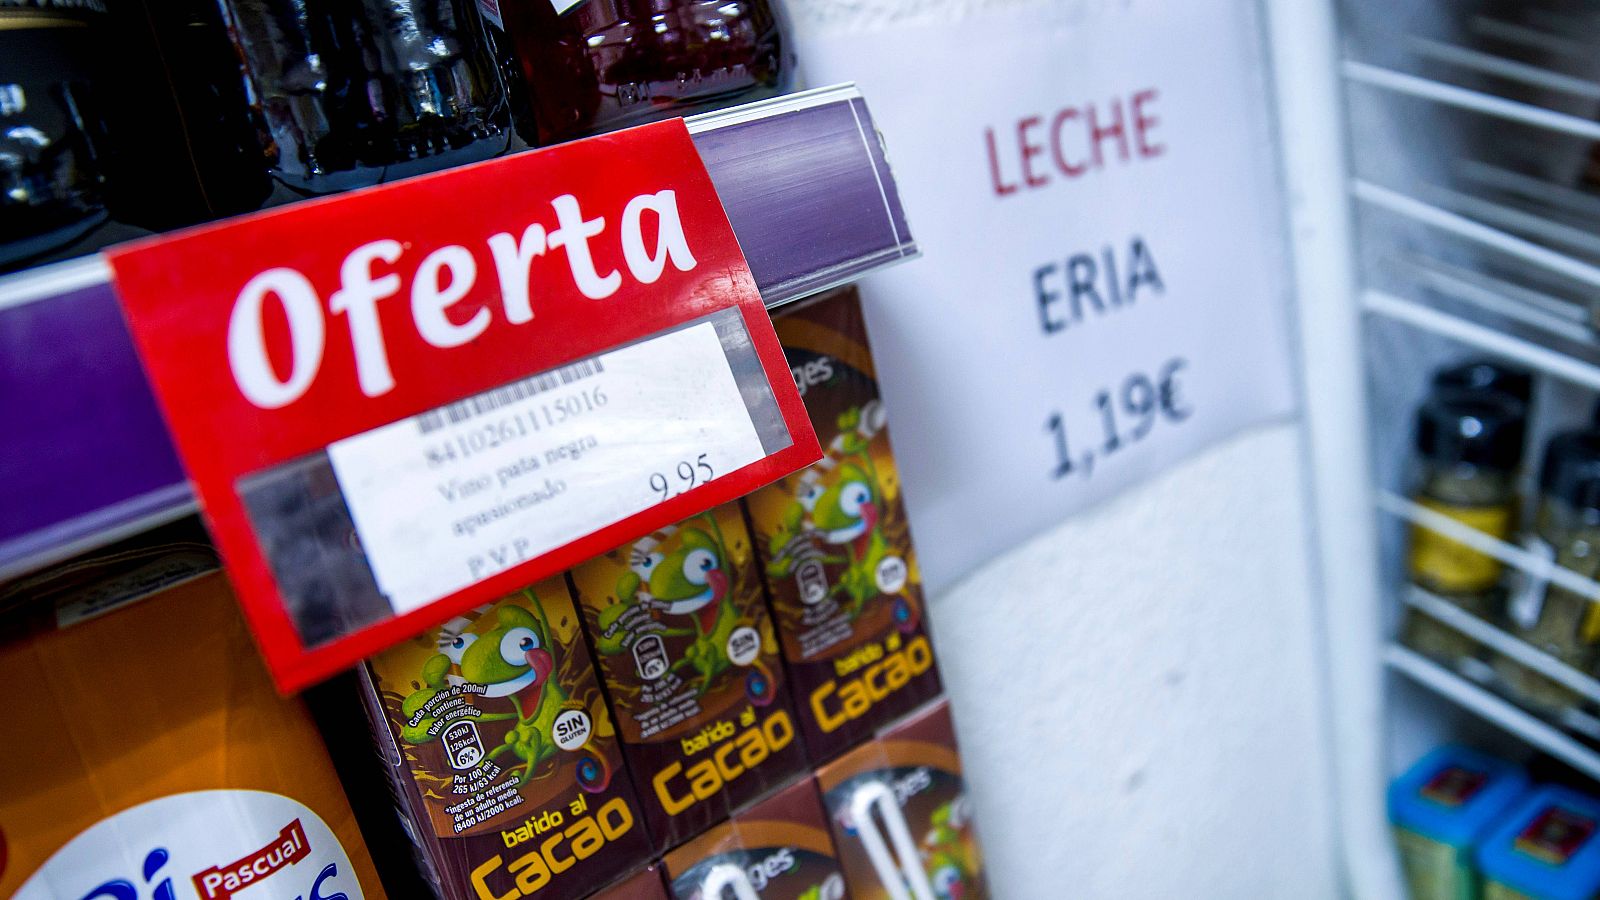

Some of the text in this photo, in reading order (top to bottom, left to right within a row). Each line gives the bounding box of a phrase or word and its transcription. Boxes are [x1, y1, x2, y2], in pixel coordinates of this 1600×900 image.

[985, 88, 1167, 197] LECHE
[227, 189, 697, 409] Oferta
[1033, 235, 1165, 335] ERIA
[1043, 356, 1195, 480] 1,19€
[438, 435, 599, 502] Vino pata negra
[453, 478, 568, 538] apasionado
[409, 684, 487, 727] Cada porción de 200ml
[432, 697, 466, 718] contiene:
[810, 636, 933, 733] Cacao
[428, 706, 482, 737] Valor energético
[557, 714, 584, 737] SIN
[560, 728, 587, 744] GLUTEN
[681, 705, 757, 756] batido al
[453, 766, 501, 794] 265 kJ/63 kcal
[454, 761, 494, 785] Por 100 ml:
[476, 793, 485, 802] de
[486, 776, 520, 798] referencia
[653, 709, 794, 816] Cacao
[454, 788, 518, 822] de un adulto medio
[454, 817, 476, 834] (8400
[476, 804, 505, 822] kJ/2000
[502, 793, 589, 848] batido al
[202, 829, 302, 898] Pascual
[471, 797, 634, 900] Cacao
